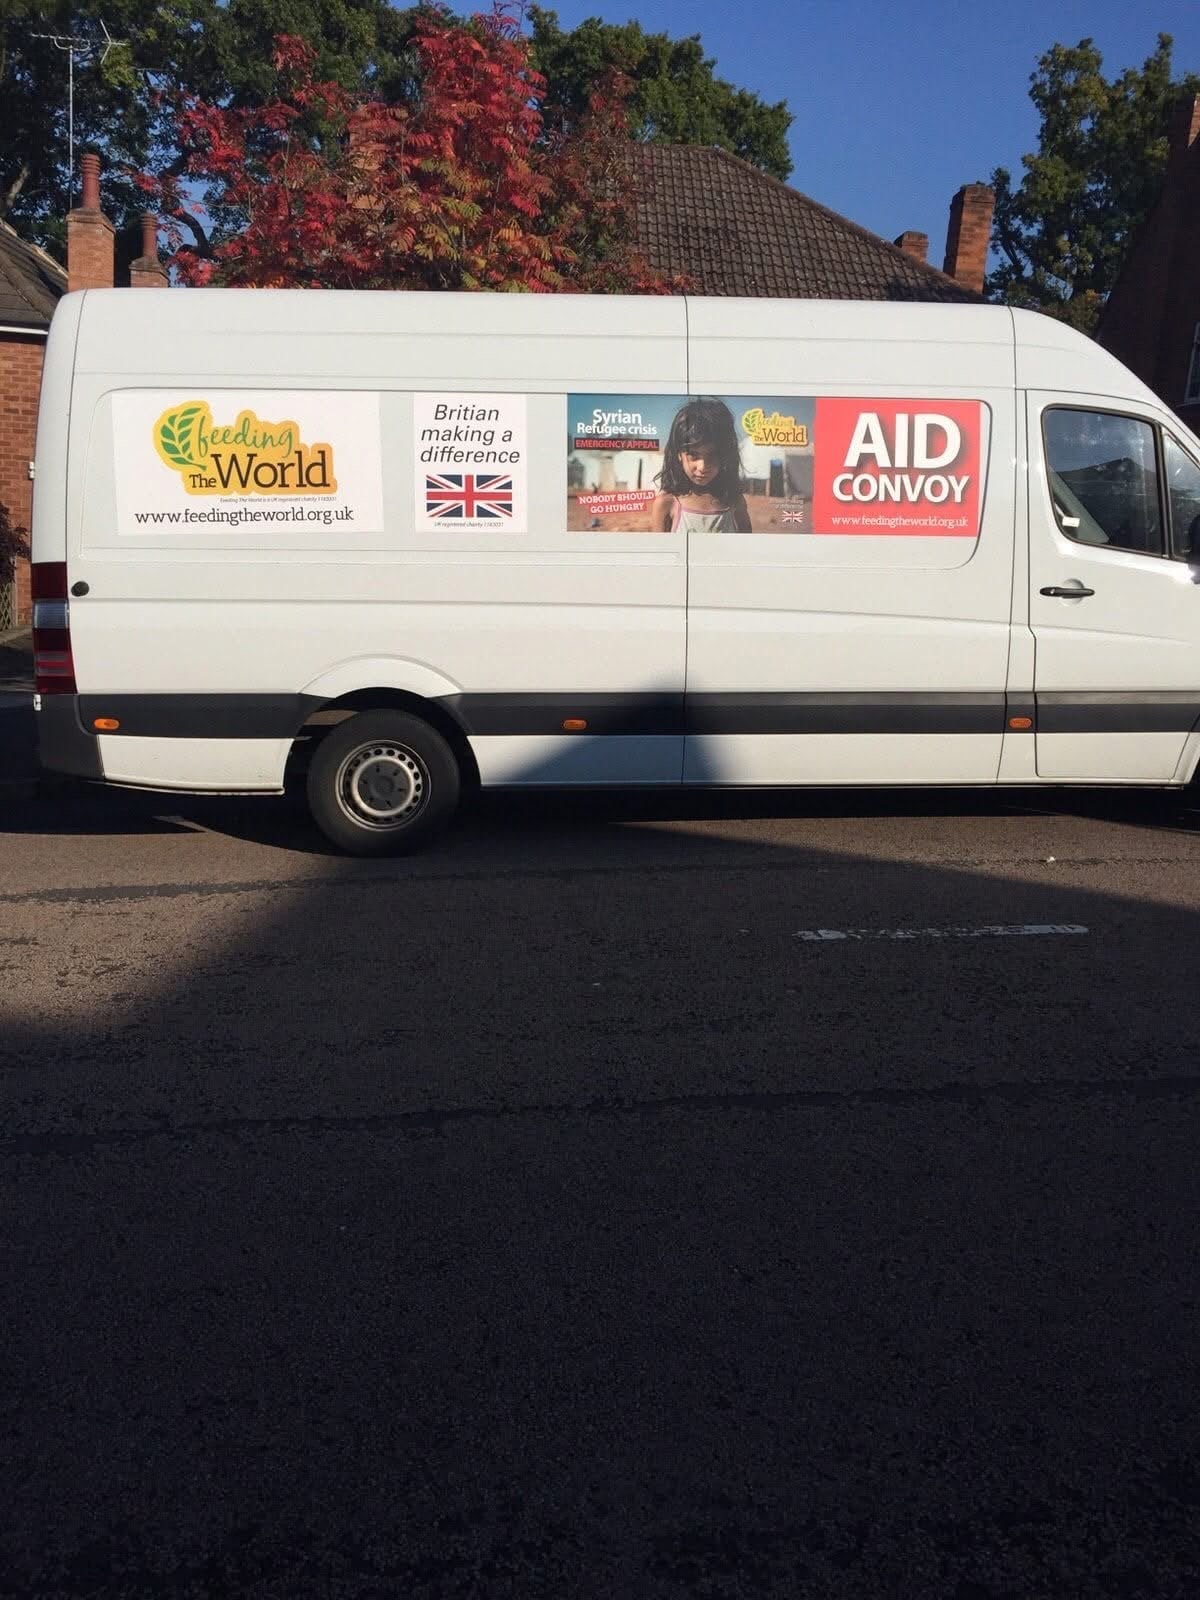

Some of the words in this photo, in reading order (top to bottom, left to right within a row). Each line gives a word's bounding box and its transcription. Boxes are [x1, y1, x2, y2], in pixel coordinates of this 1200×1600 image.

[434, 404, 500, 421] Britian
[592, 409, 642, 426] Syrian
[197, 415, 293, 458] feeding
[421, 425, 495, 446] making
[501, 430, 513, 442] a
[577, 422, 627, 437] Refugee
[628, 424, 658, 435] crisis
[762, 428, 805, 443] World
[575, 439, 625, 448] EMERGENCY
[626, 440, 658, 449] APPEAL
[843, 412, 961, 469] AID
[420, 446, 520, 463] difference
[189, 474, 217, 489] The
[210, 450, 331, 489] World
[832, 473, 970, 503] CONVOY
[579, 494, 616, 505] NOBODY
[617, 491, 654, 502] SHOULD
[134, 506, 354, 527] www.feedingtheworld.org.uk
[590, 505, 604, 514] GO
[605, 502, 645, 513] HUNGRY
[831, 515, 968, 529] www.feedingtheworld.org.uk
